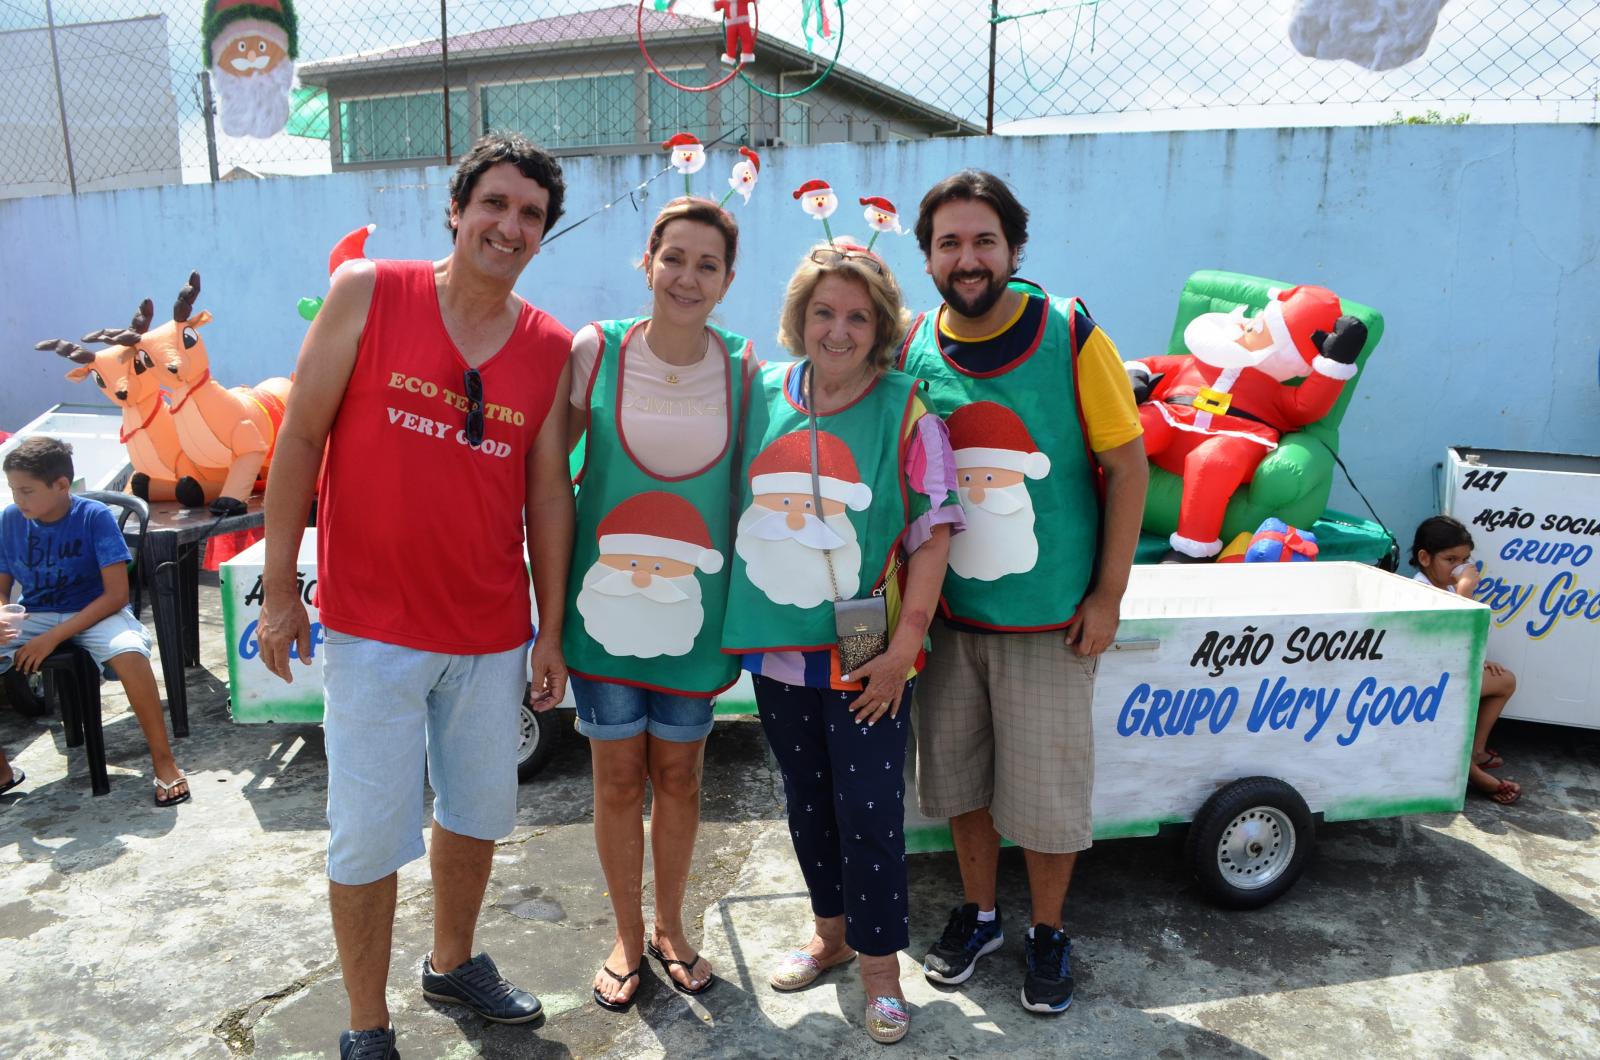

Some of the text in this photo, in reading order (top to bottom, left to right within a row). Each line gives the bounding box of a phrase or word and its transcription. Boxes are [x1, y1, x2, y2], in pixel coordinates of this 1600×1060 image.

[387, 372, 526, 427] ECO TETRO
[386, 407, 512, 458] VERY GOD
[1462, 470, 1508, 492] 141
[1472, 507, 1535, 532] AÇÃO
[1500, 537, 1593, 567] GRUPO
[1472, 560, 1536, 626] ery
[1190, 625, 1386, 677] AÇÃO SOCIAL
[1116, 671, 1450, 746] GRUPO Very Good
